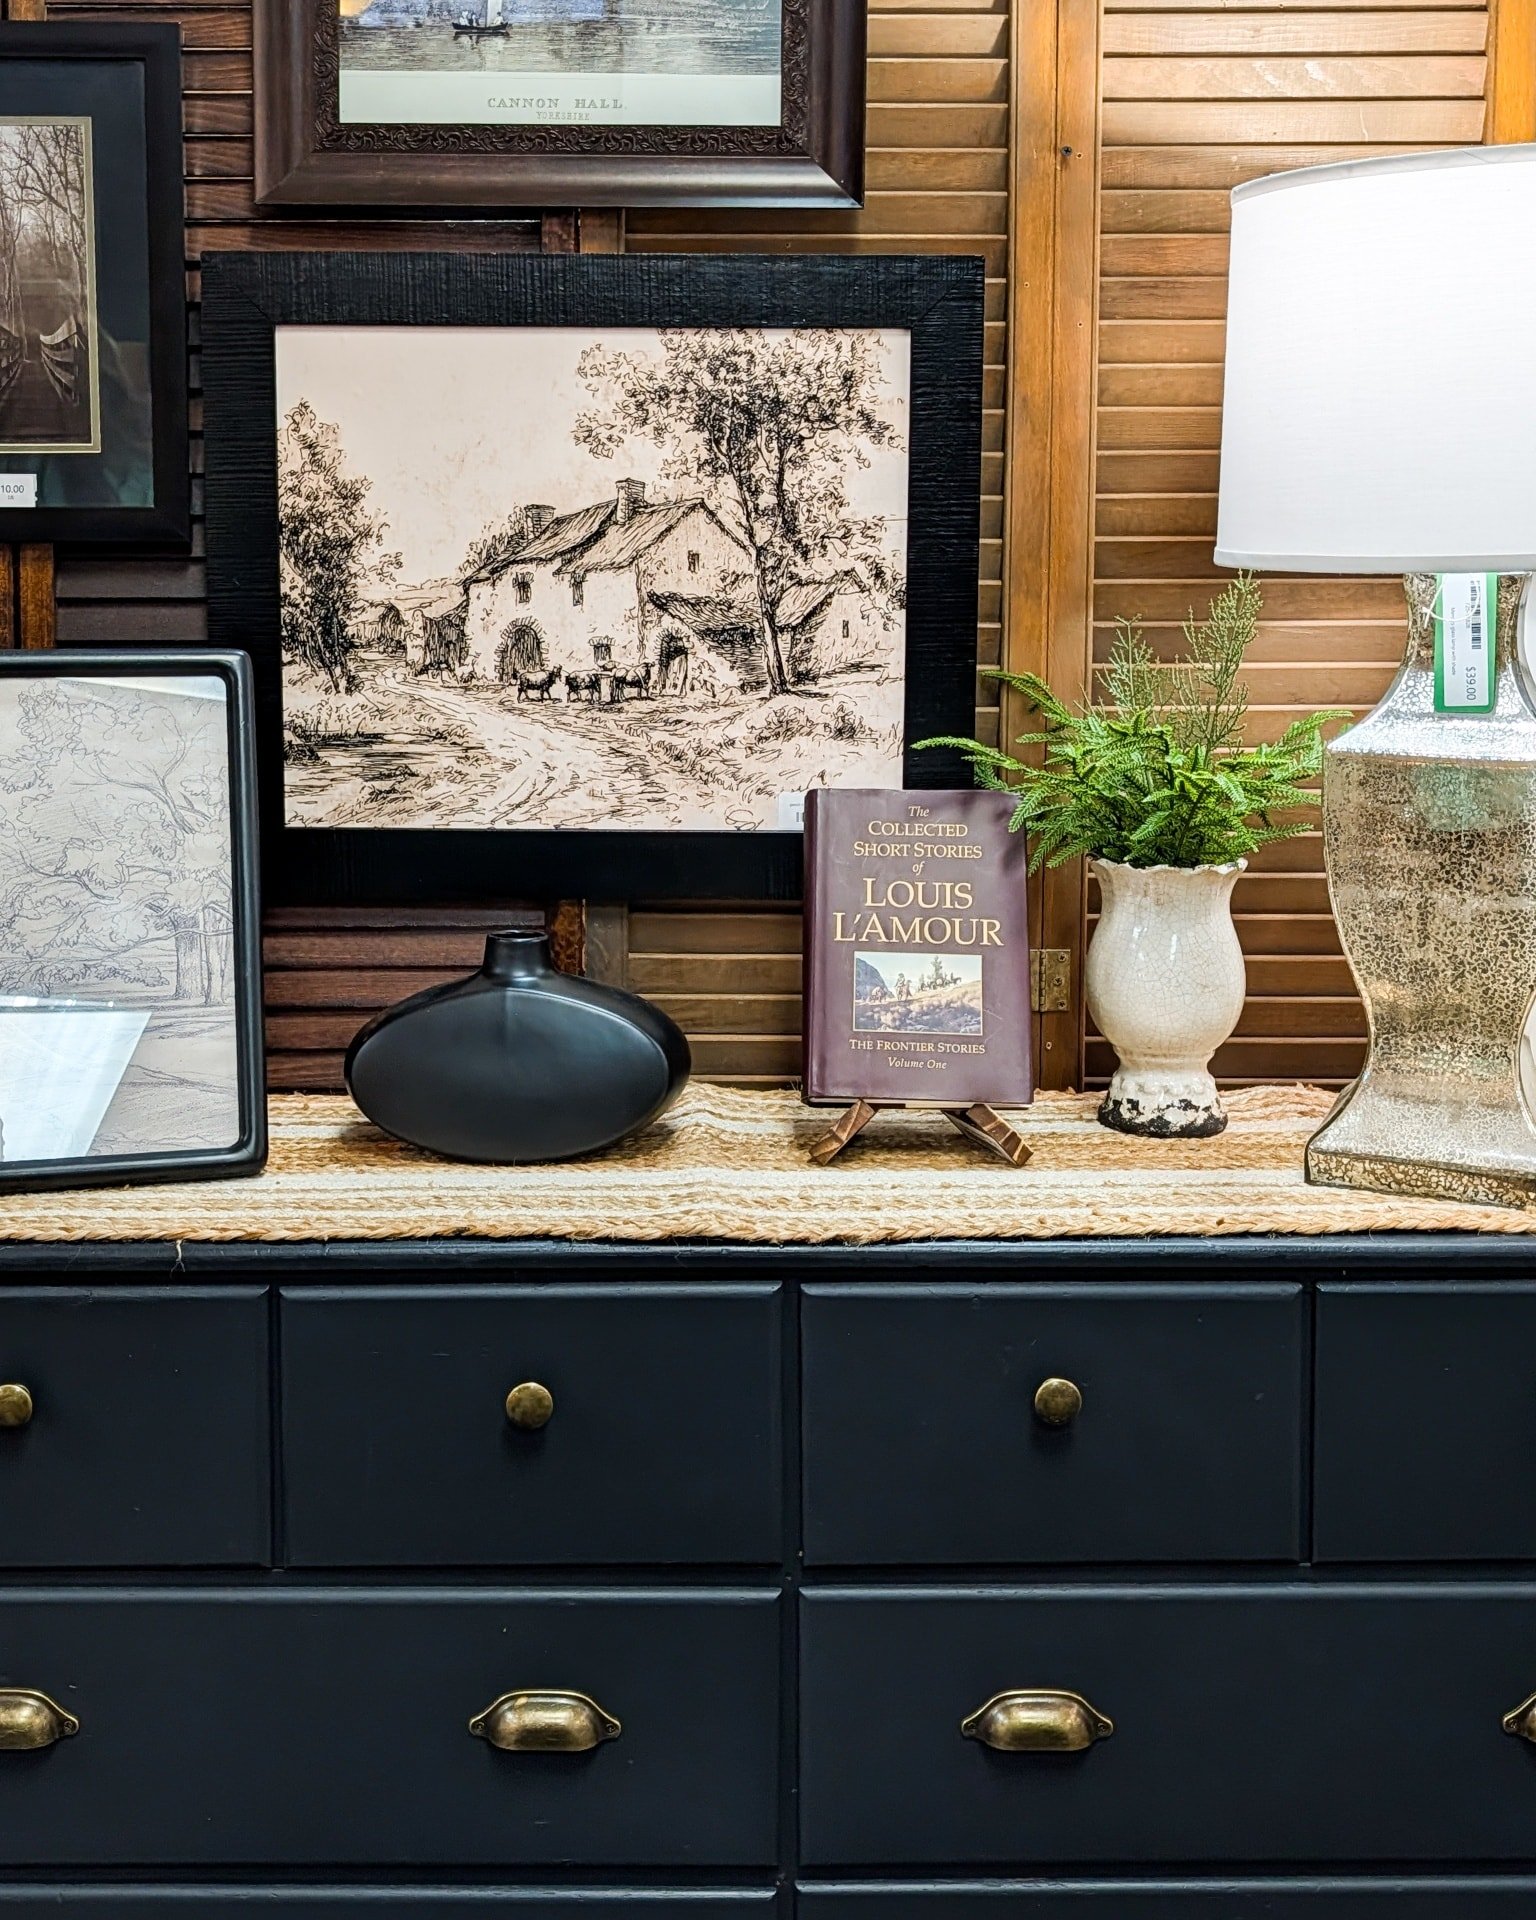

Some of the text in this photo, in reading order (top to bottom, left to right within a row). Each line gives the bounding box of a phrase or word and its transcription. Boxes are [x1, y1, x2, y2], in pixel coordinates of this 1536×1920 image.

[487, 98, 560, 108] CANNON
[536, 111, 590, 120] YORKSHIRE
[1465, 666, 1477, 701] $39.00
[908, 805, 930, 817] The
[868, 820, 968, 837] COLLECTED
[853, 841, 983, 859] SHORT STORIES
[912, 861, 925, 876] of
[862, 877, 973, 910] LOUIS
[832, 912, 1004, 946] L'AMOUR
[849, 1039, 986, 1054] THE FRONTIER STORIES
[887, 1057, 947, 1070] Volume One
